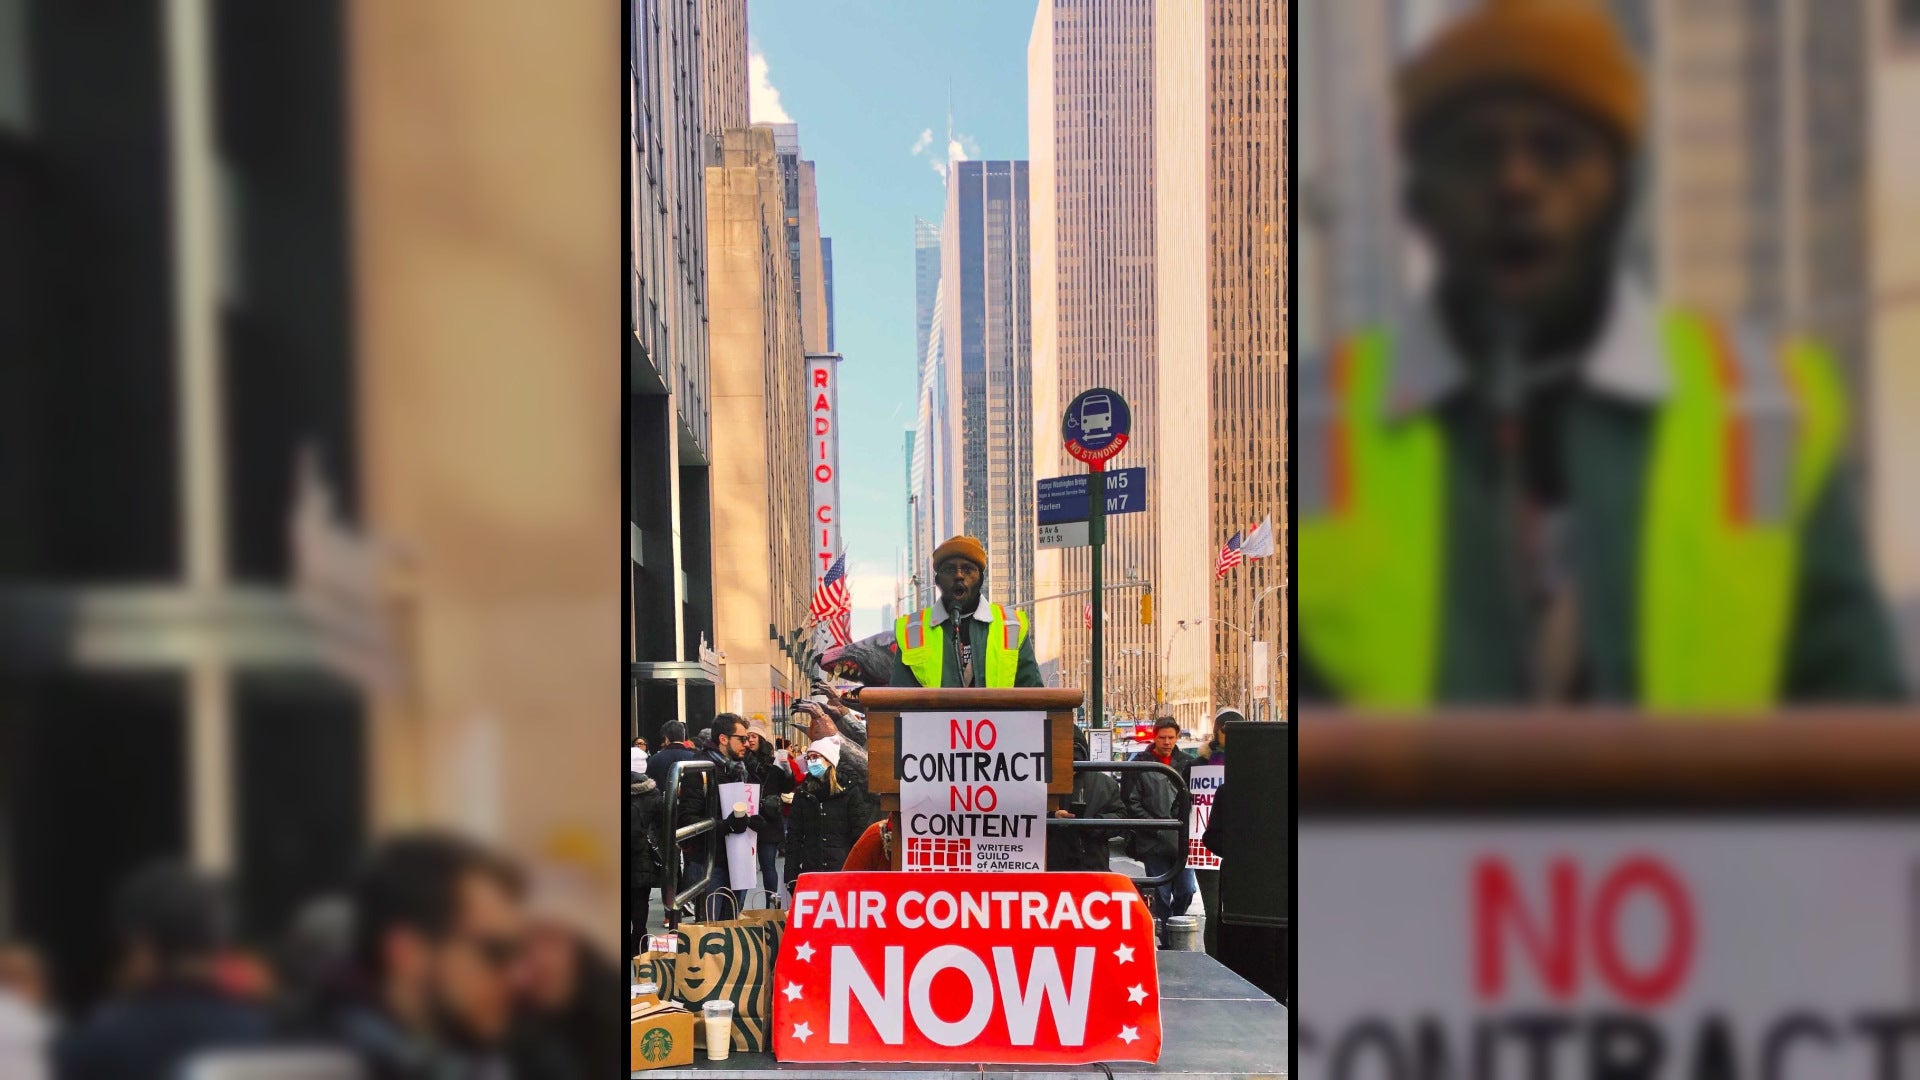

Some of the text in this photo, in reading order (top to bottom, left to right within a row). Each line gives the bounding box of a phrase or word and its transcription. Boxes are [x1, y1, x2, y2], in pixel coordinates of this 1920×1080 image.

[1069, 437, 1123, 460] NO STANDING
[812, 368, 834, 582] RADIO CIT
[1106, 472, 1128, 490] M5
[1039, 503, 1060, 511] Harlem
[1106, 494, 1128, 511] M7
[1044, 526, 1053, 534] Av
[1056, 534, 1063, 542] St
[950, 719, 997, 751] NO
[901, 751, 1046, 783] CONTRACT
[950, 784, 998, 813] NO
[910, 813, 1038, 838] CONTENT
[976, 851, 1010, 861] GUILD
[977, 843, 1024, 852] WRITERS
[976, 861, 1040, 870] of AMERICA
[793, 890, 1138, 930] FAIR CONTRACT
[1471, 852, 1702, 1012] NO
[828, 944, 1096, 1047] NOW
